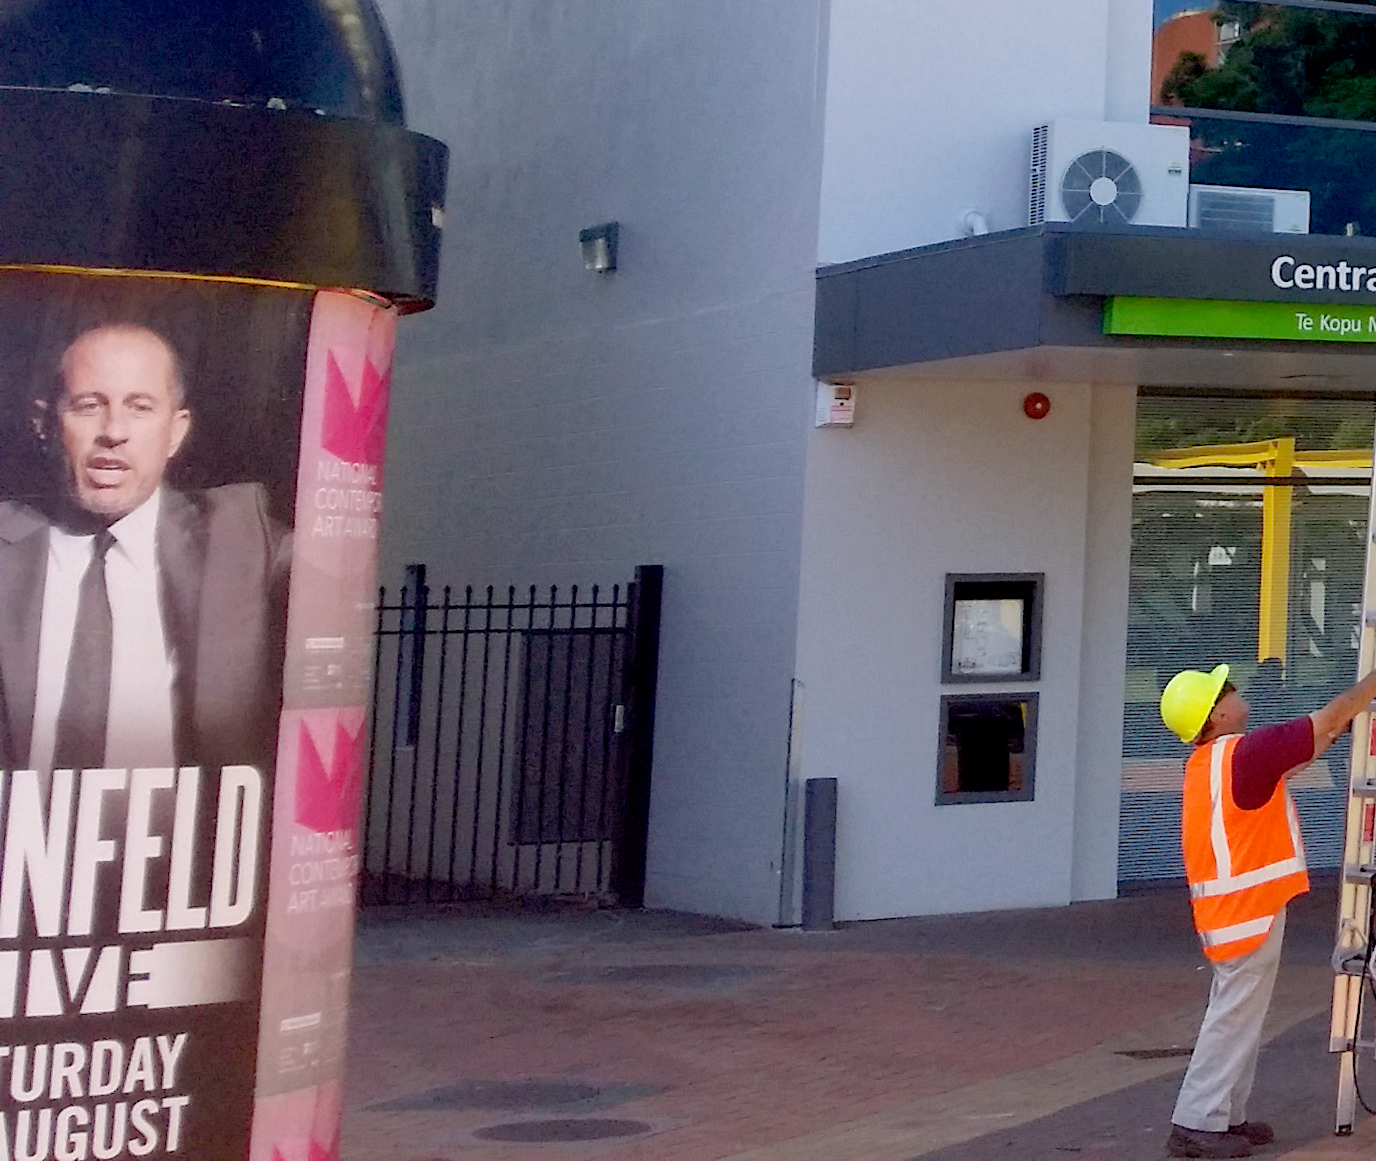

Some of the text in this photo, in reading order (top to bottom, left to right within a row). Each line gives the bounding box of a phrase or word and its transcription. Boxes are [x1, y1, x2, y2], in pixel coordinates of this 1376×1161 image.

[1295, 312, 1314, 331] Te
[1320, 314, 1361, 336] Kopu
[311, 516, 344, 538] ART
[0, 765, 262, 938] NFELD
[286, 890, 320, 915] ART
